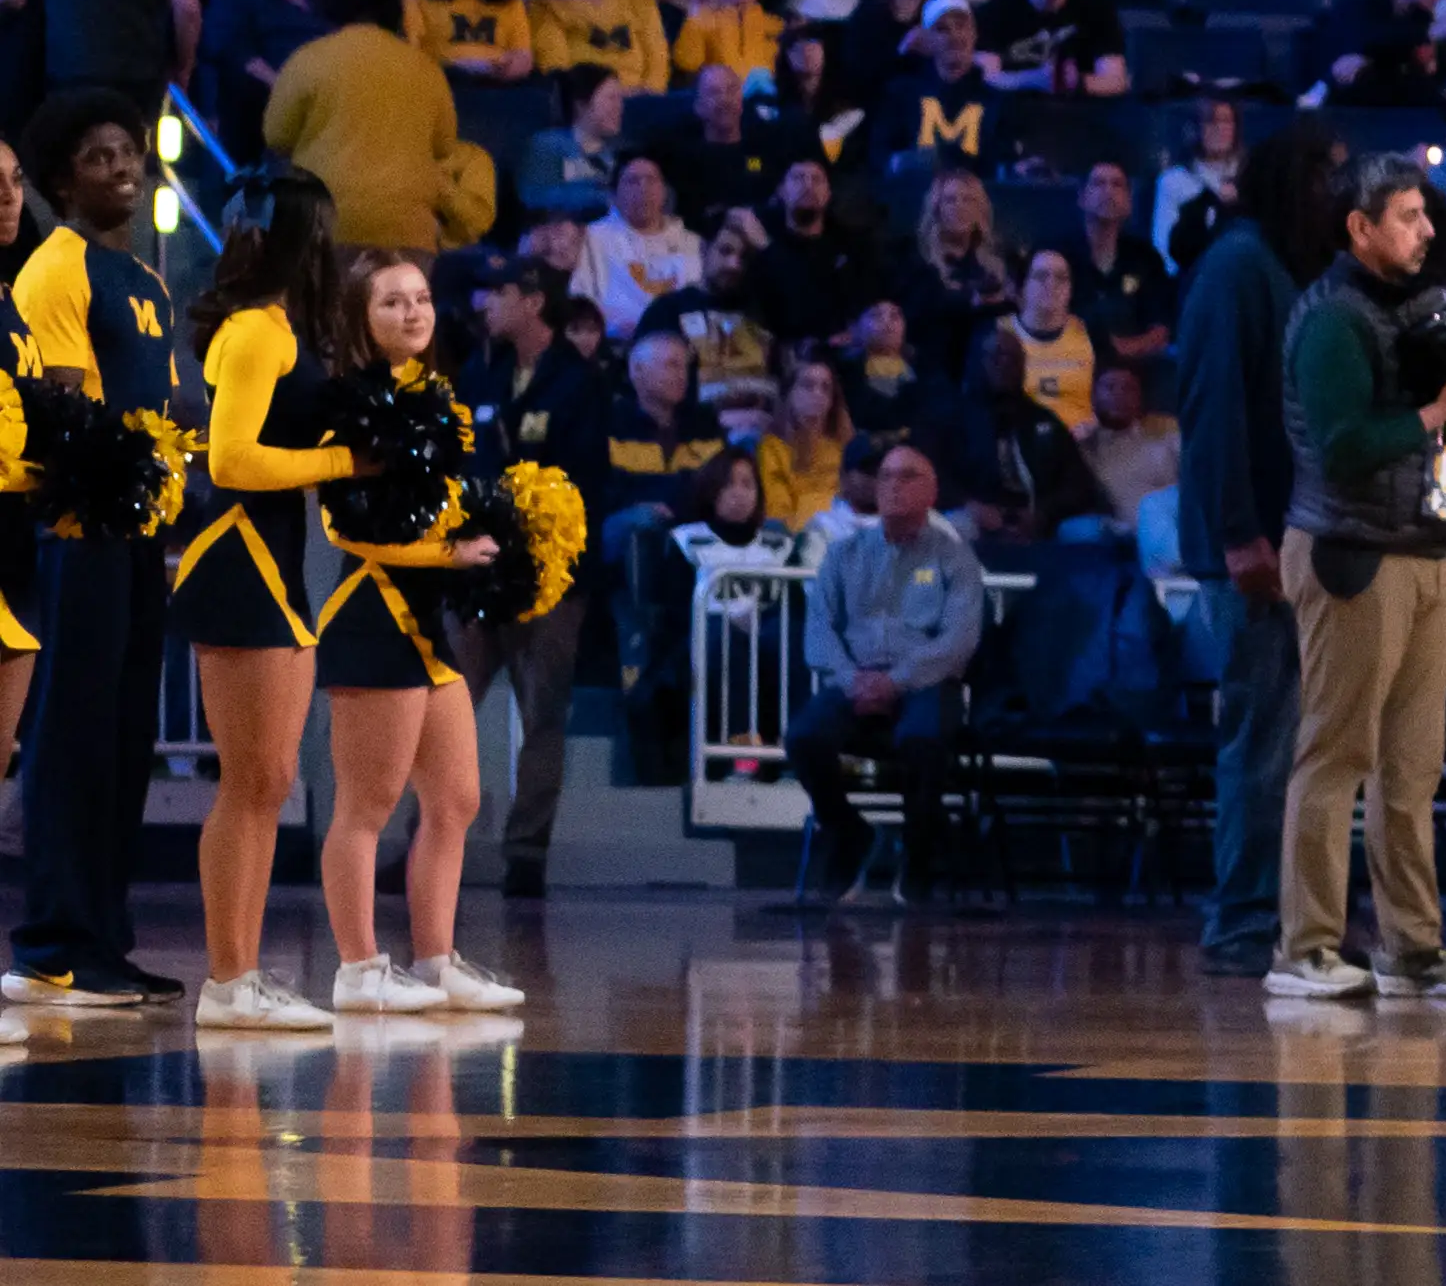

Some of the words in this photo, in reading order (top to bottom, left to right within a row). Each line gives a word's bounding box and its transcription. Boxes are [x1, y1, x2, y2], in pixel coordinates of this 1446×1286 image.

[450, 13, 498, 45] M
[917, 95, 985, 156] M
[128, 296, 163, 338] M
[9, 331, 43, 379] M
